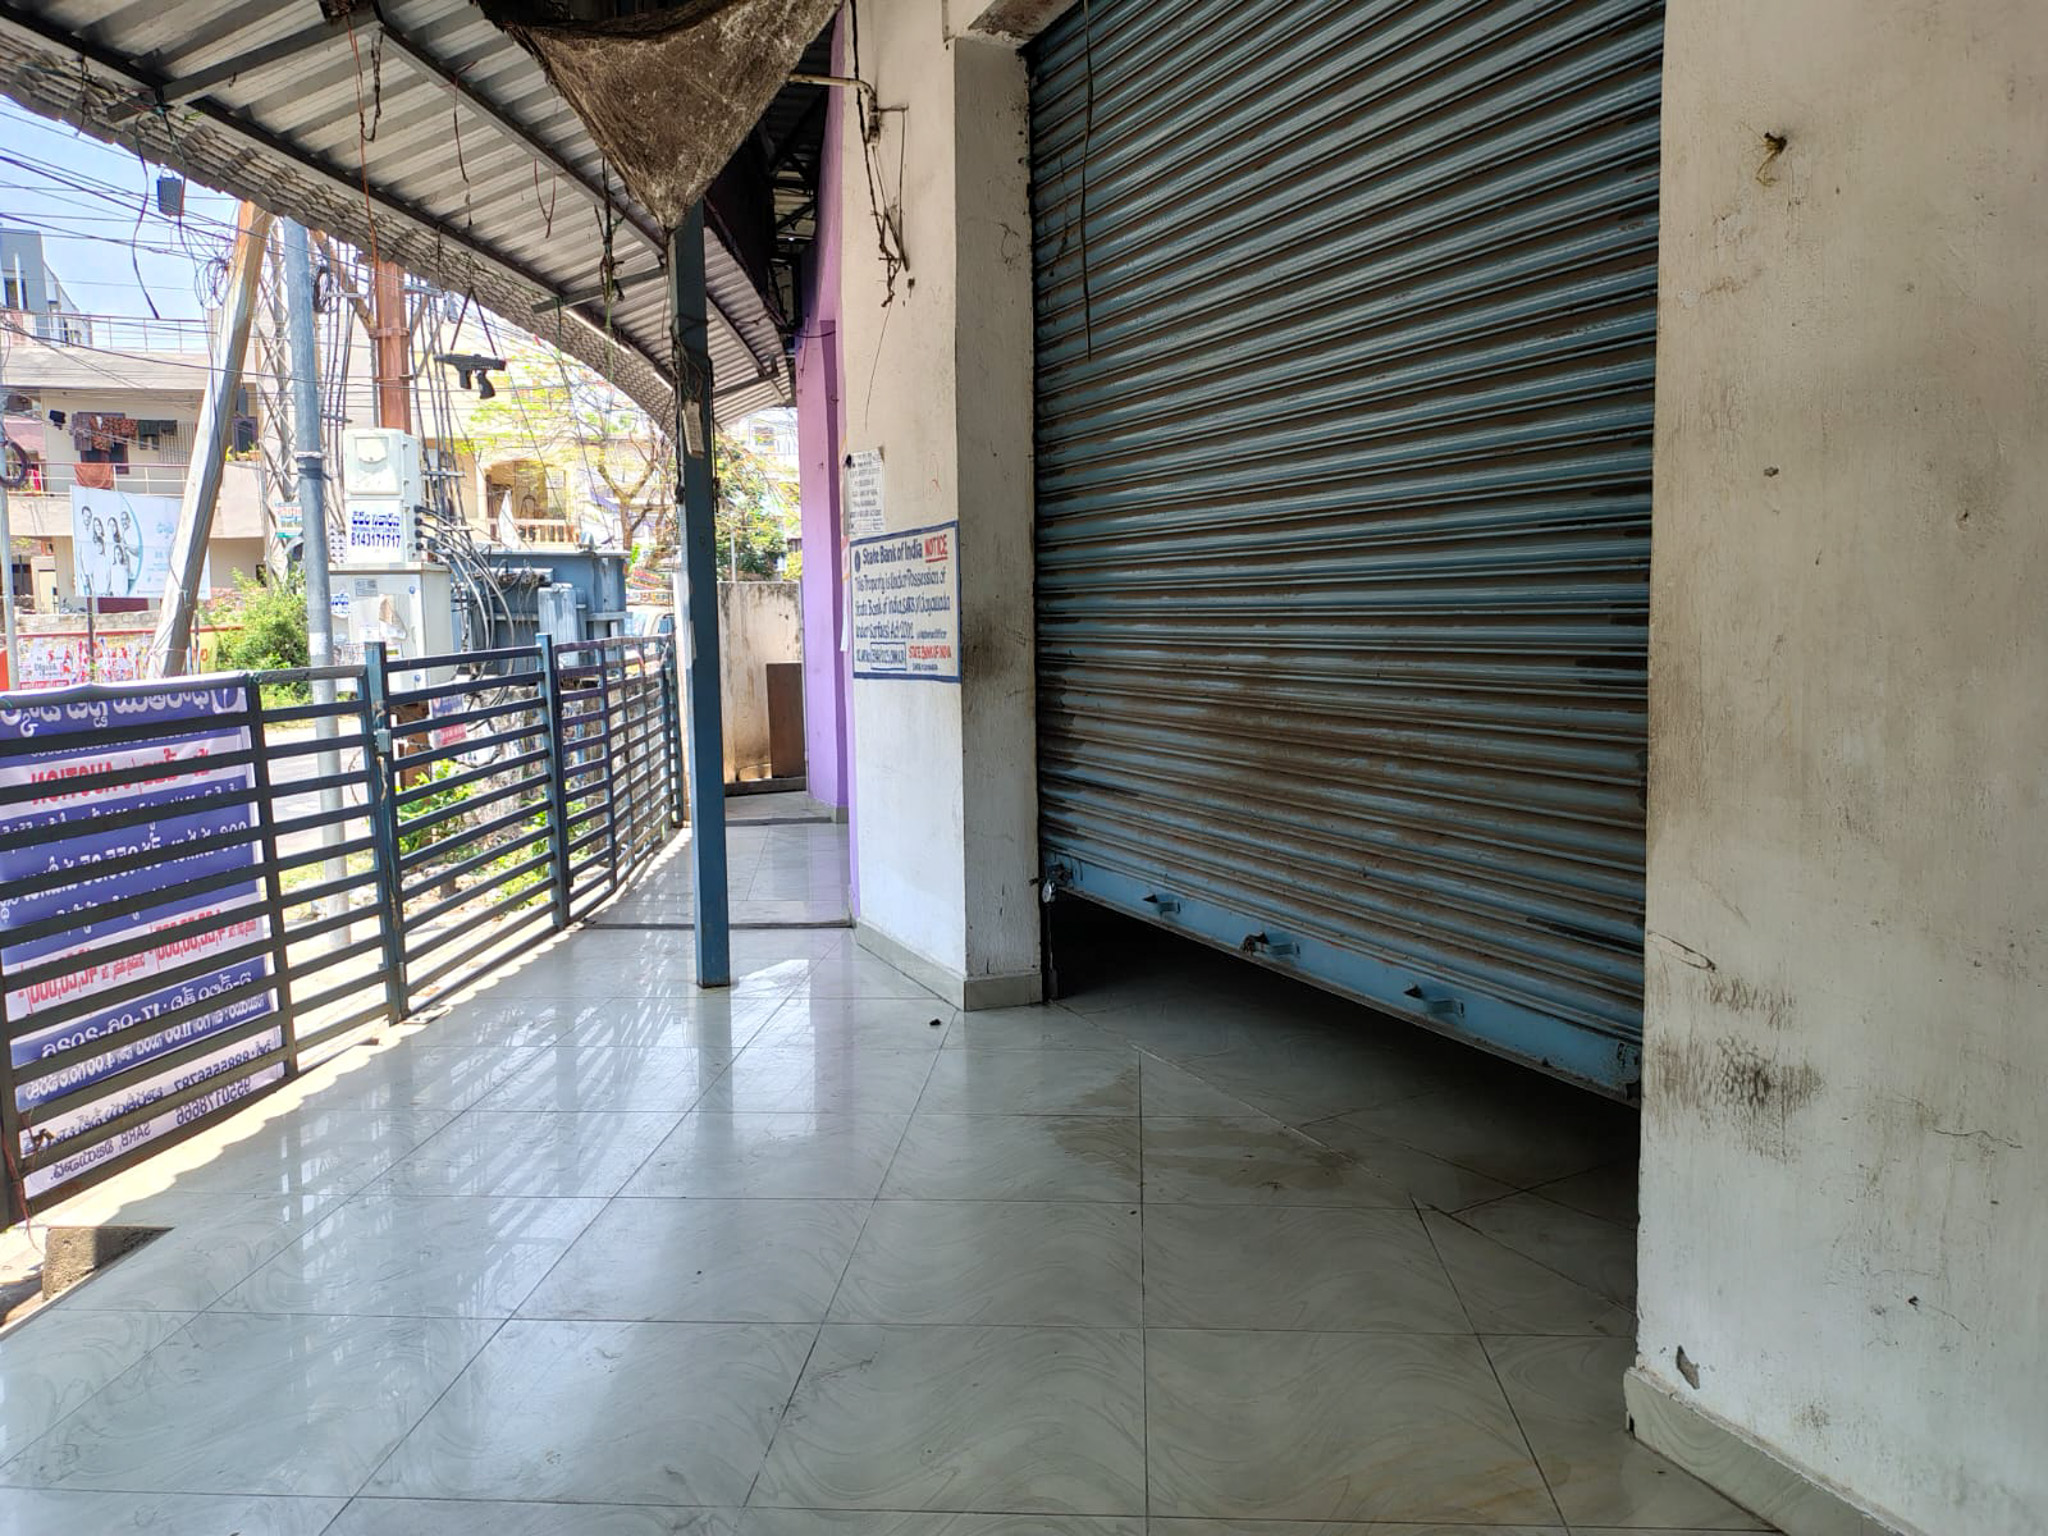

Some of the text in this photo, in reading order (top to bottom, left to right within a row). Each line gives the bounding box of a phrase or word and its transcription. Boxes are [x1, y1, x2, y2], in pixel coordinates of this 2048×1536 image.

[863, 534, 948, 565] State Bank of India NOTICE
